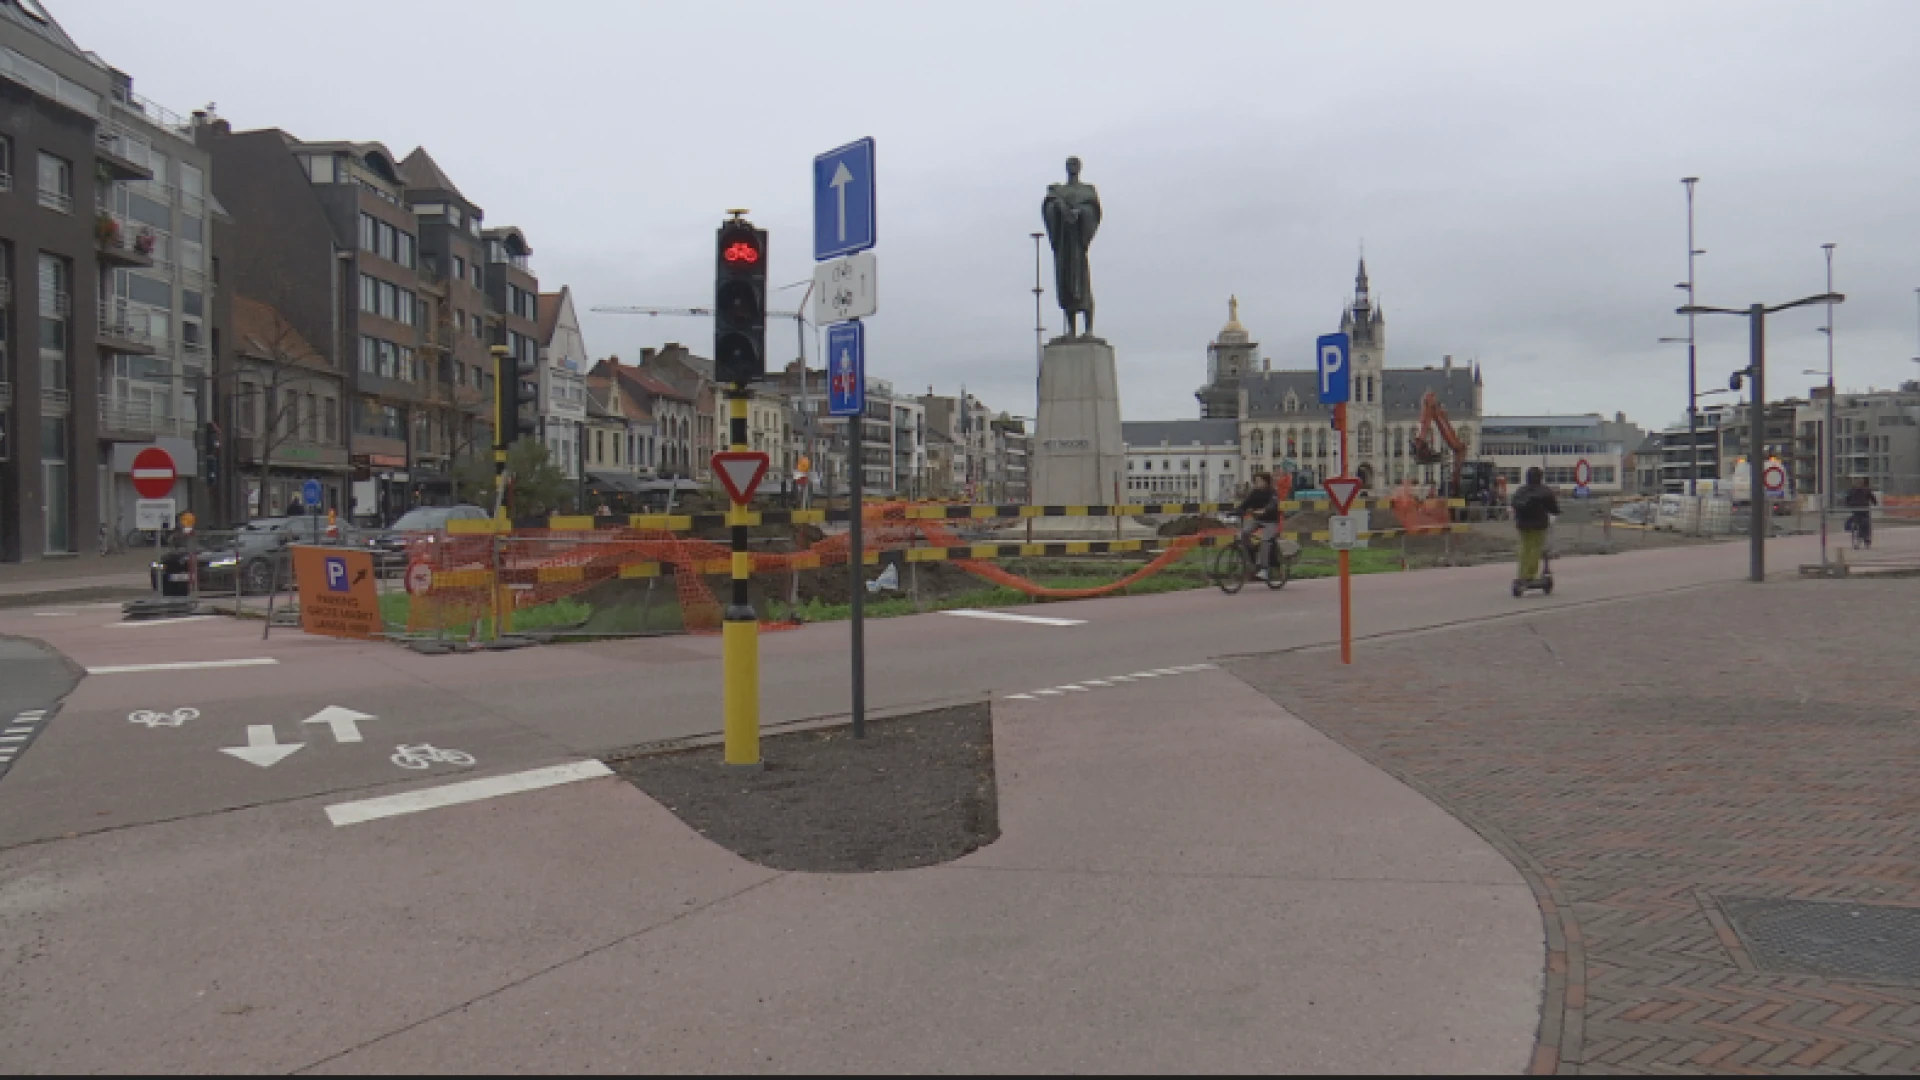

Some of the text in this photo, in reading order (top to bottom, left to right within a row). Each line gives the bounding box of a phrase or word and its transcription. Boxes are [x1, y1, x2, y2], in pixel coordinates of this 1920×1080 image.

[1321, 345, 1342, 394] P
[327, 561, 344, 587] P
[316, 594, 359, 608] PARKING
